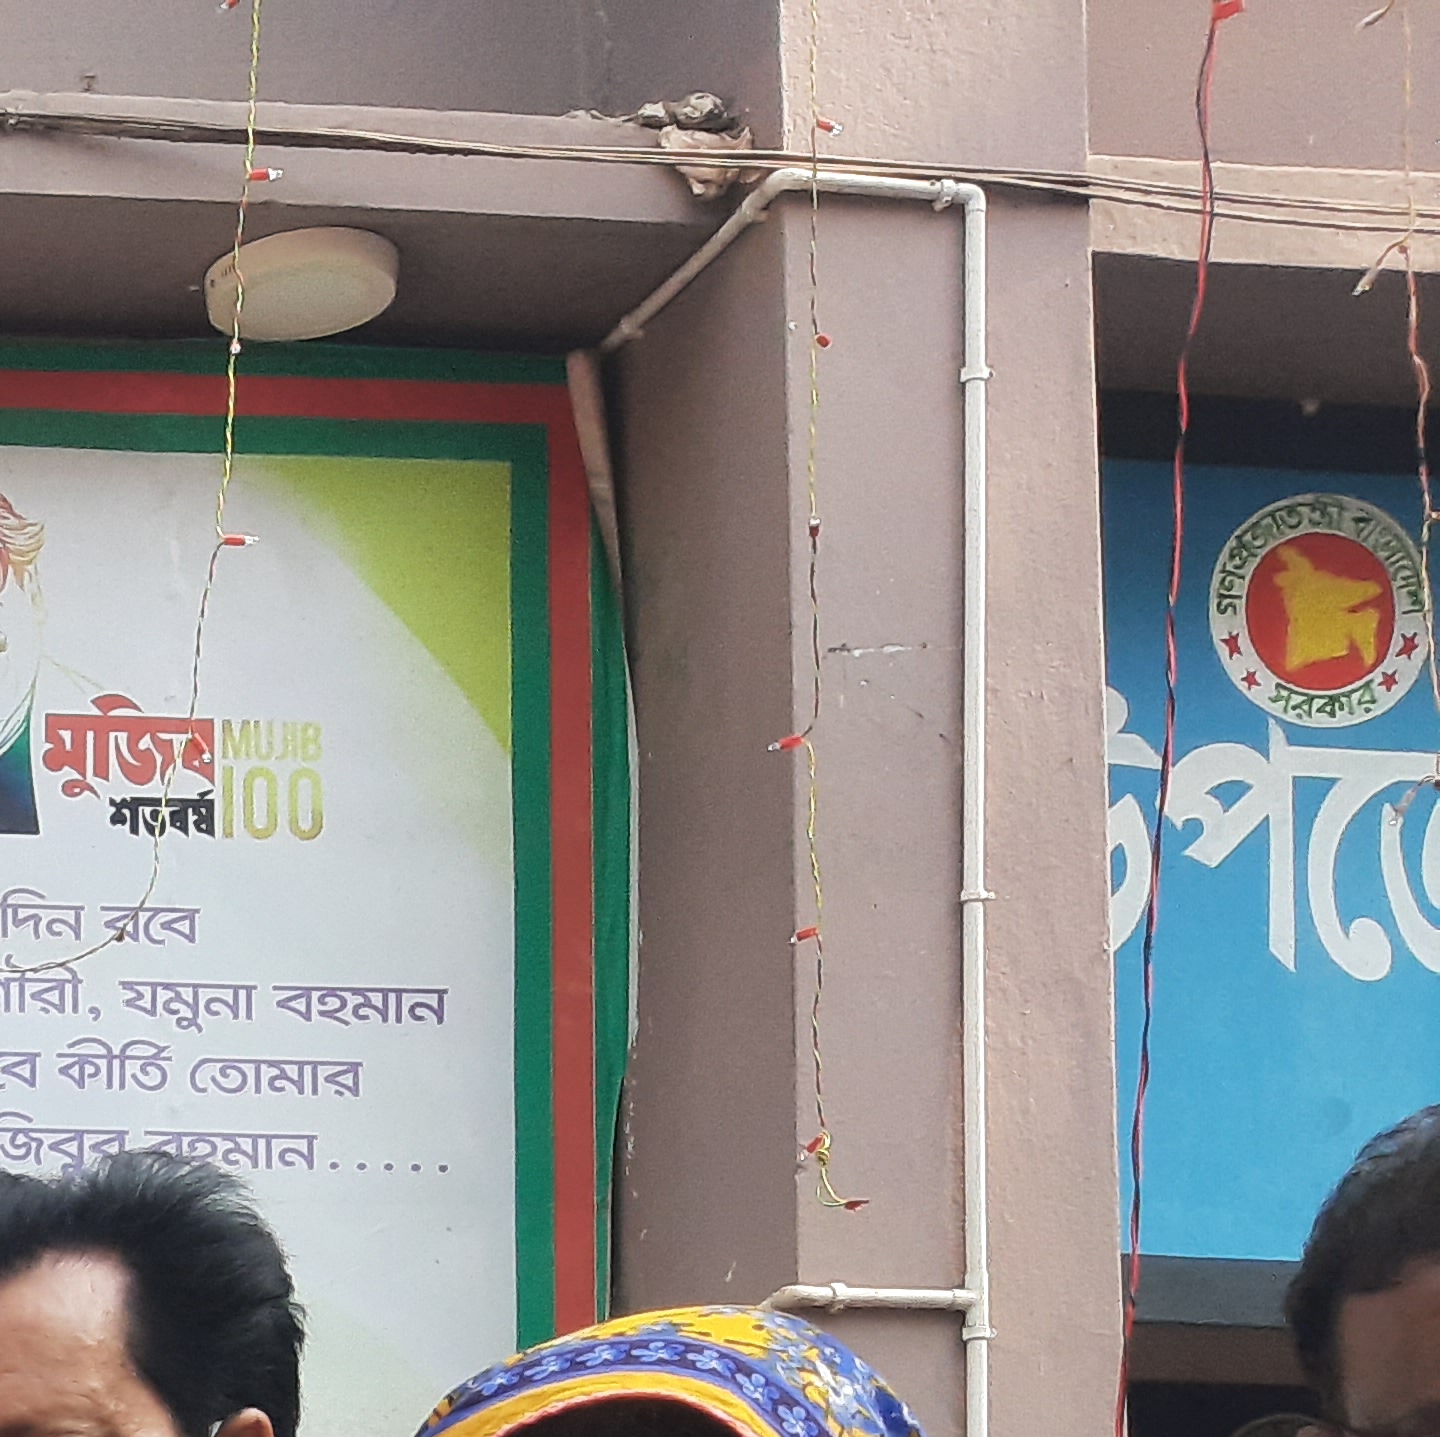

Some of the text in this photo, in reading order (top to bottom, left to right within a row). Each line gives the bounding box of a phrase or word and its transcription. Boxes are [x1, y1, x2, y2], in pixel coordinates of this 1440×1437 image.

[1268, 679, 1377, 718] সরকার
[42, 694, 215, 799] মুজিব
[222, 719, 323, 760] MUJIB
[109, 789, 215, 838] শতবর্ষ
[222, 765, 323, 840] 100
[101, 905, 200, 945] রবে
[120, 978, 257, 1034] যমুনা
[274, 984, 448, 1027] বহমান
[56, 1033, 174, 1095] কীর্তি
[189, 1057, 363, 1100] তোমার
